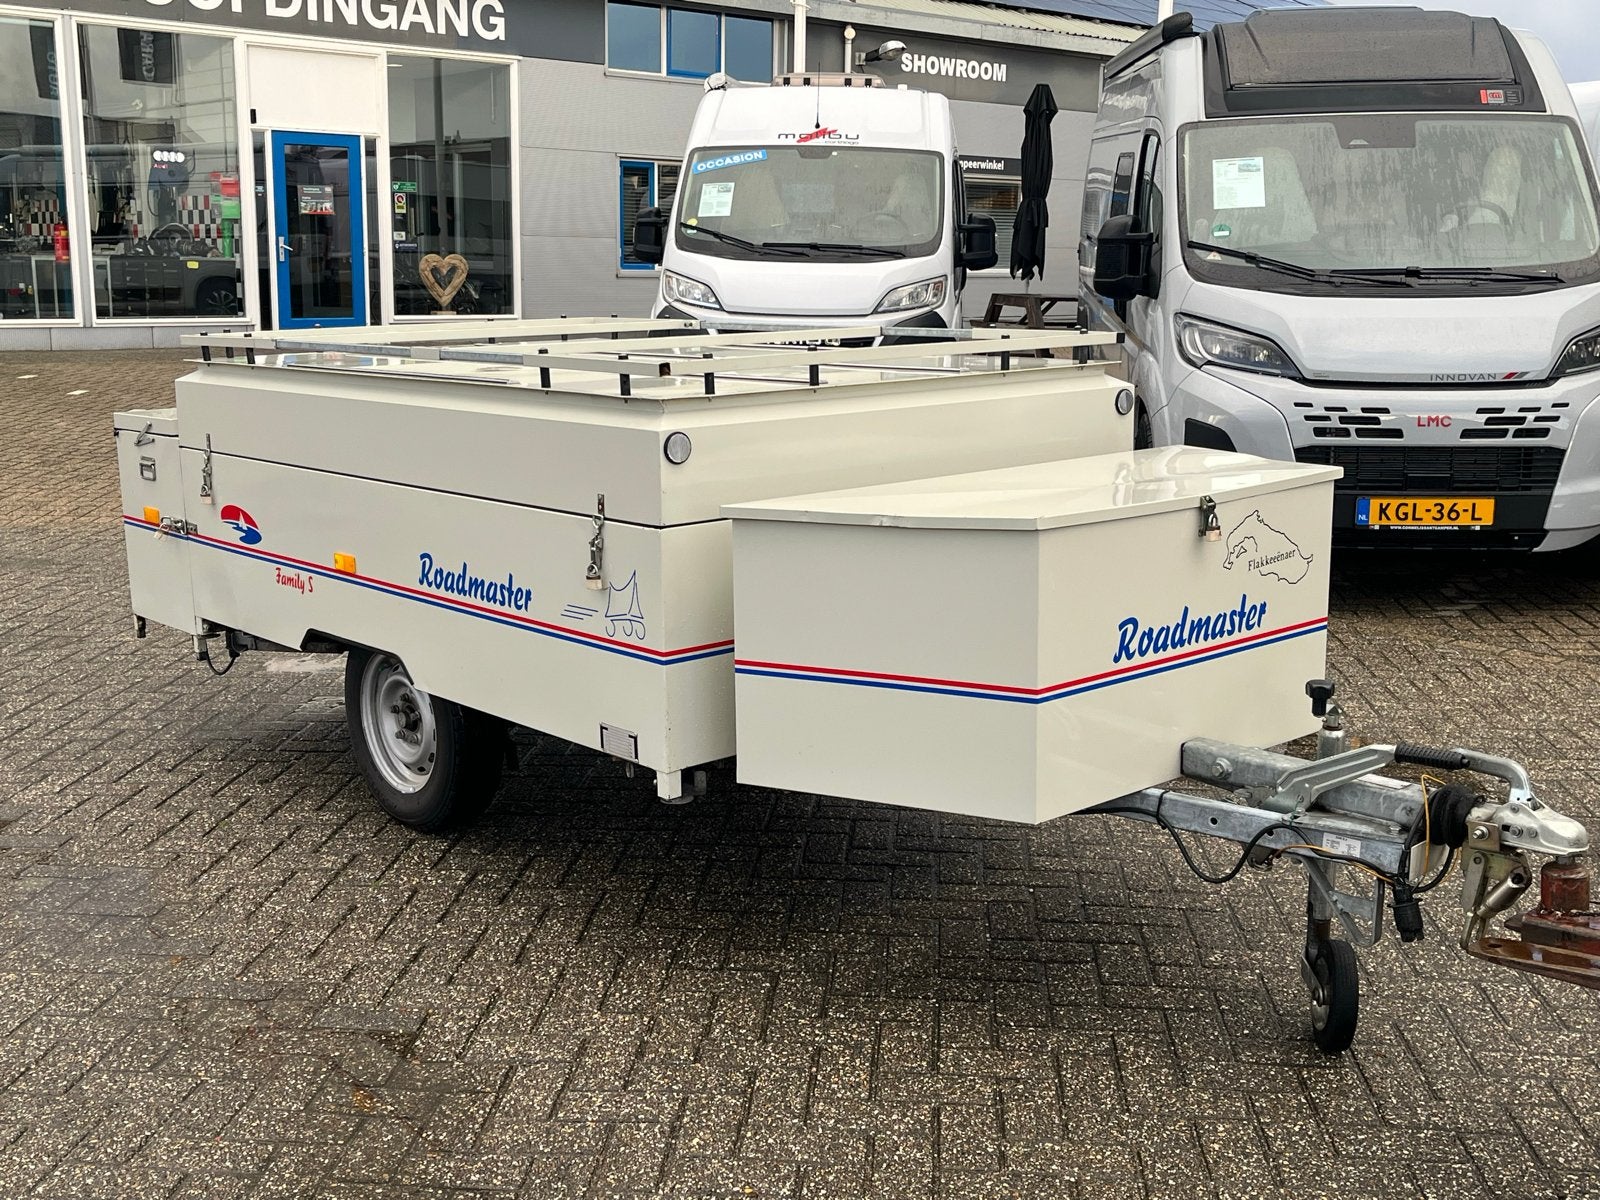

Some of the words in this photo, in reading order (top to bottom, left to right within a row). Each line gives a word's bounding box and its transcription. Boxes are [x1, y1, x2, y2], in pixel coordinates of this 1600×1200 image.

[900, 52, 1007, 82] SHOWROOM
[697, 151, 763, 171] OCCASION
[1430, 373, 1497, 381] INNOVAN
[1417, 415, 1452, 427] LMC
[1378, 502, 1483, 521] KGL-36-L
[275, 567, 305, 595] Family
[308, 575, 314, 593] S
[419, 552, 532, 612] Roadmaster
[1112, 593, 1267, 664] Roadmaster
